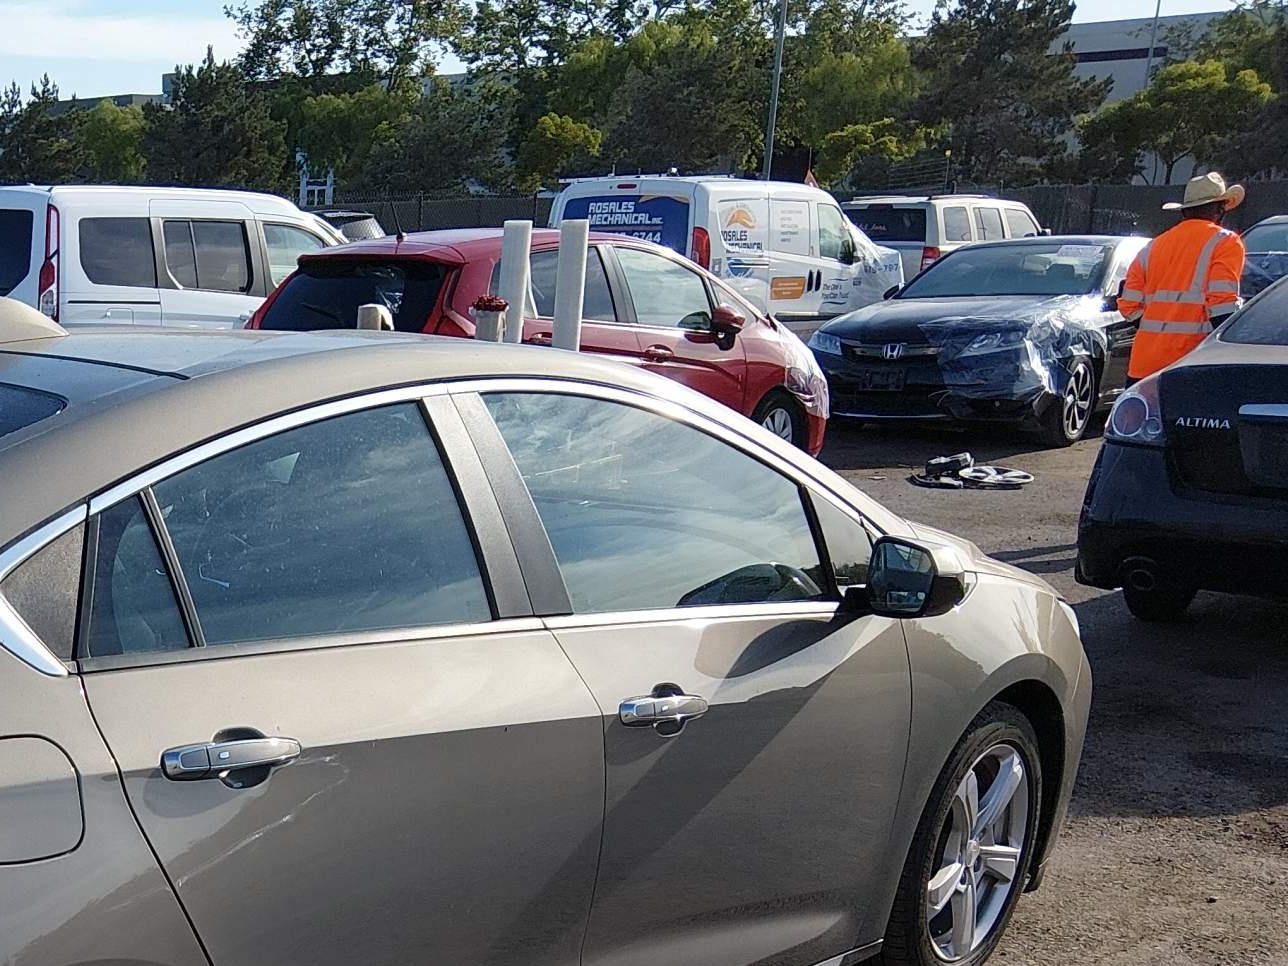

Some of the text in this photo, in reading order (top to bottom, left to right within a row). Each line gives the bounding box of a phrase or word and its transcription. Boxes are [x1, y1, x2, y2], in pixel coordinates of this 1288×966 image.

[588, 202, 635, 213] ROSALES
[588, 213, 650, 225] MECHANICAL
[1175, 416, 1231, 430] ALTIMA
